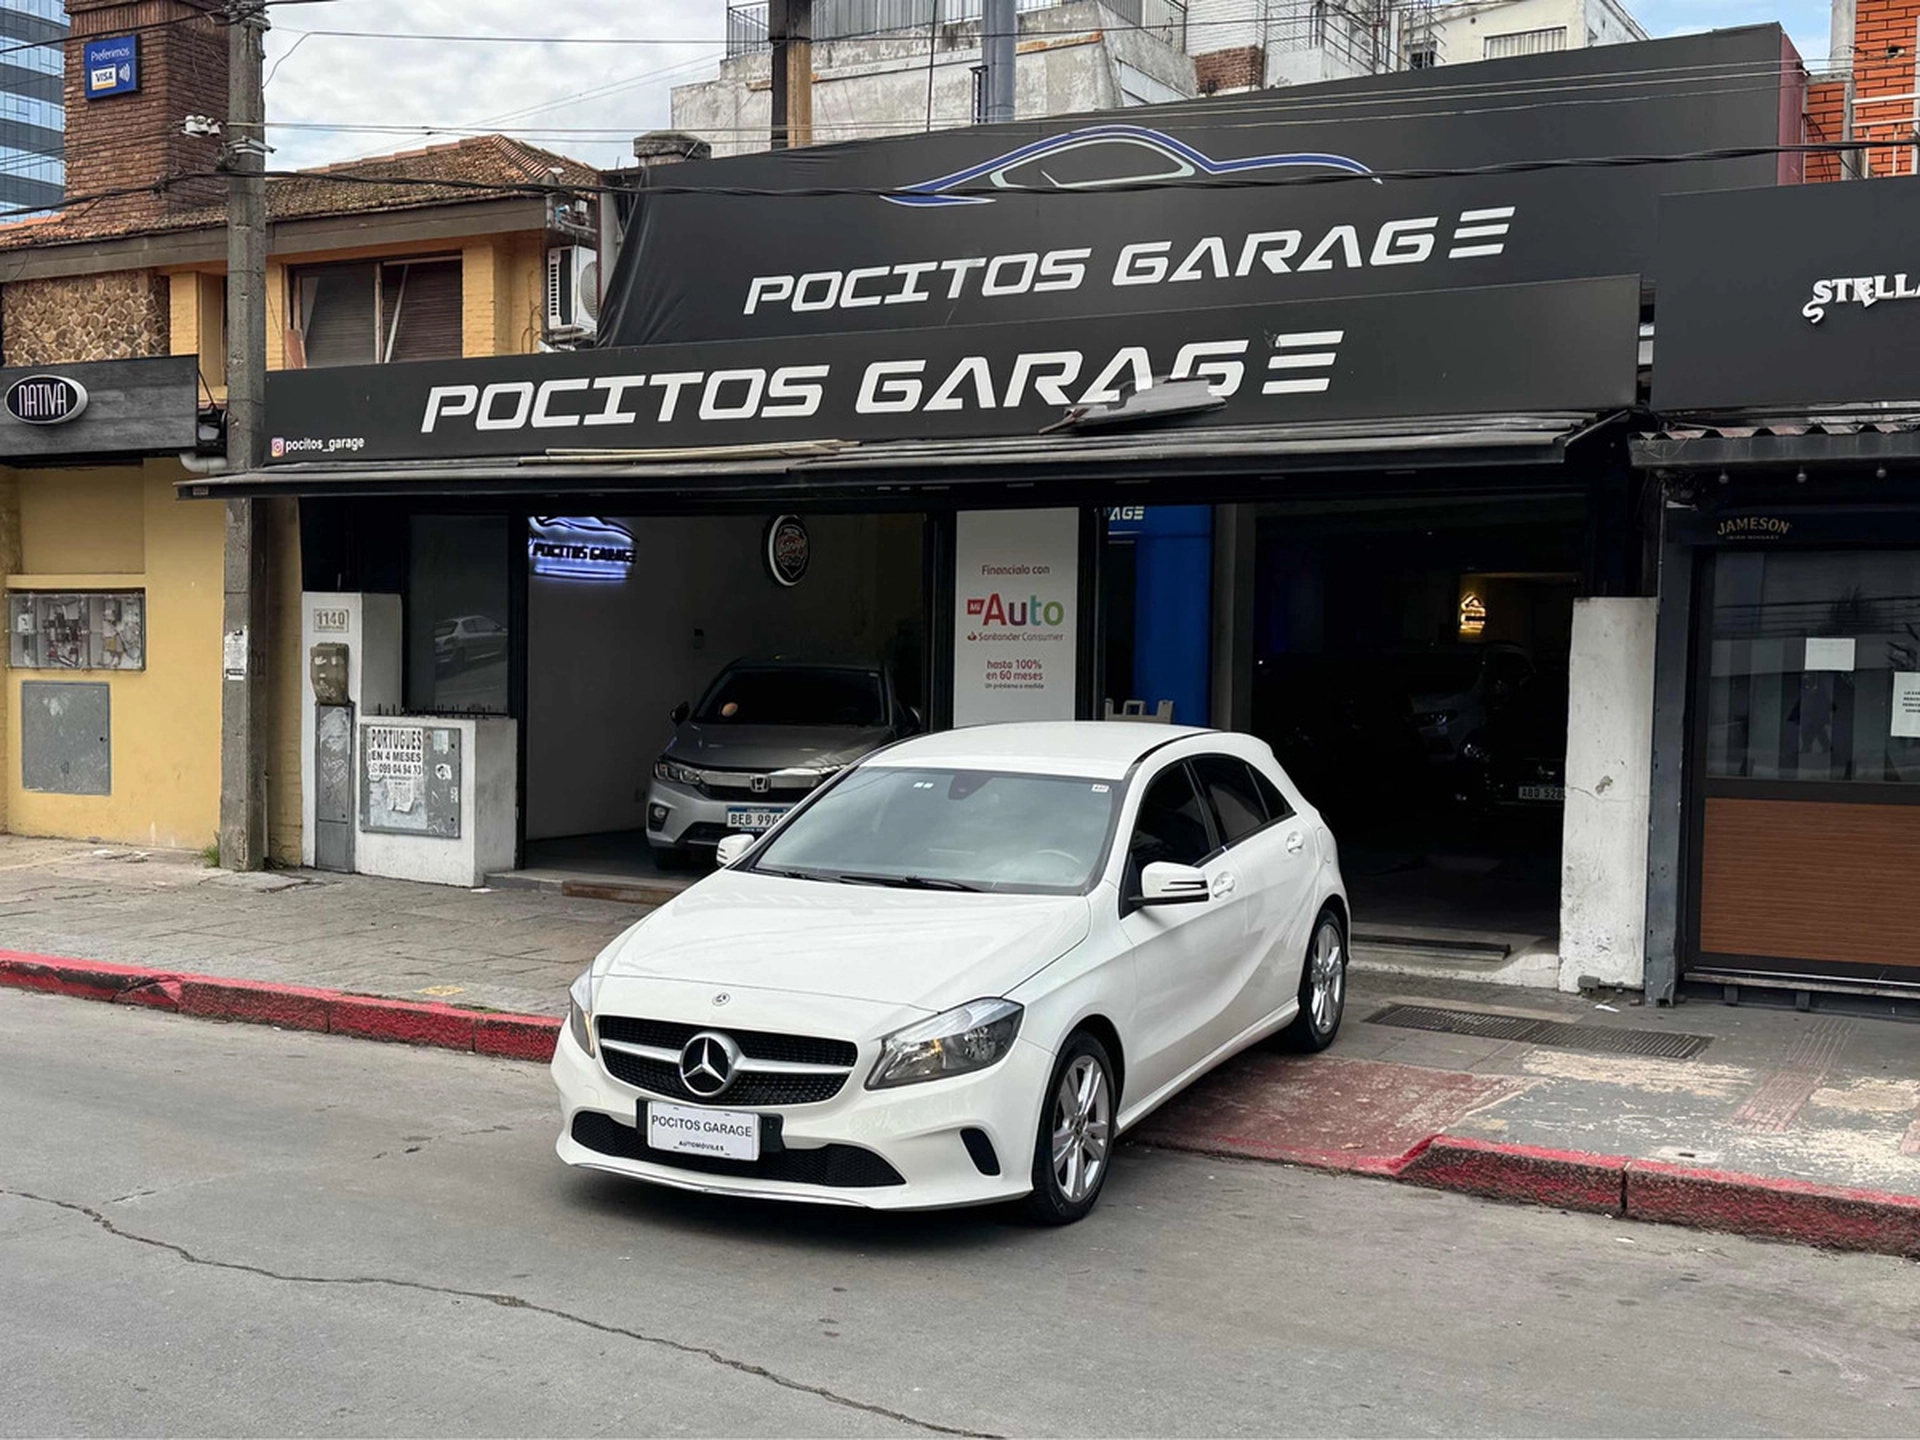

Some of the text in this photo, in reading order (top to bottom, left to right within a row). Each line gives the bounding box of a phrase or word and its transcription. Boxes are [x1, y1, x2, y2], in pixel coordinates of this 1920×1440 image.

[91, 47, 130, 61] Preferimos
[95, 71, 113, 82] VISA
[744, 206, 1516, 315] POCITOS GARAGE
[420, 330, 1344, 433] POCITOS GARAGE
[18, 382, 67, 416] NATIVA
[285, 437, 365, 453] pocitos_garage
[1717, 517, 1790, 535] JAMESON
[532, 543, 588, 559] POCITOS
[1032, 565, 1050, 575] con
[983, 593, 1064, 626] Auto
[316, 612, 345, 625] 1140
[979, 632, 1064, 641] Santander Consumer
[1016, 660, 1042, 669] 100%
[986, 670, 1043, 680] en 60 meses
[371, 729, 422, 750] PORTUGUES
[372, 750, 422, 763] EN 4 MESES
[731, 813, 785, 826] BEB 996
[651, 1114, 752, 1137] POCITOS GARAGE
